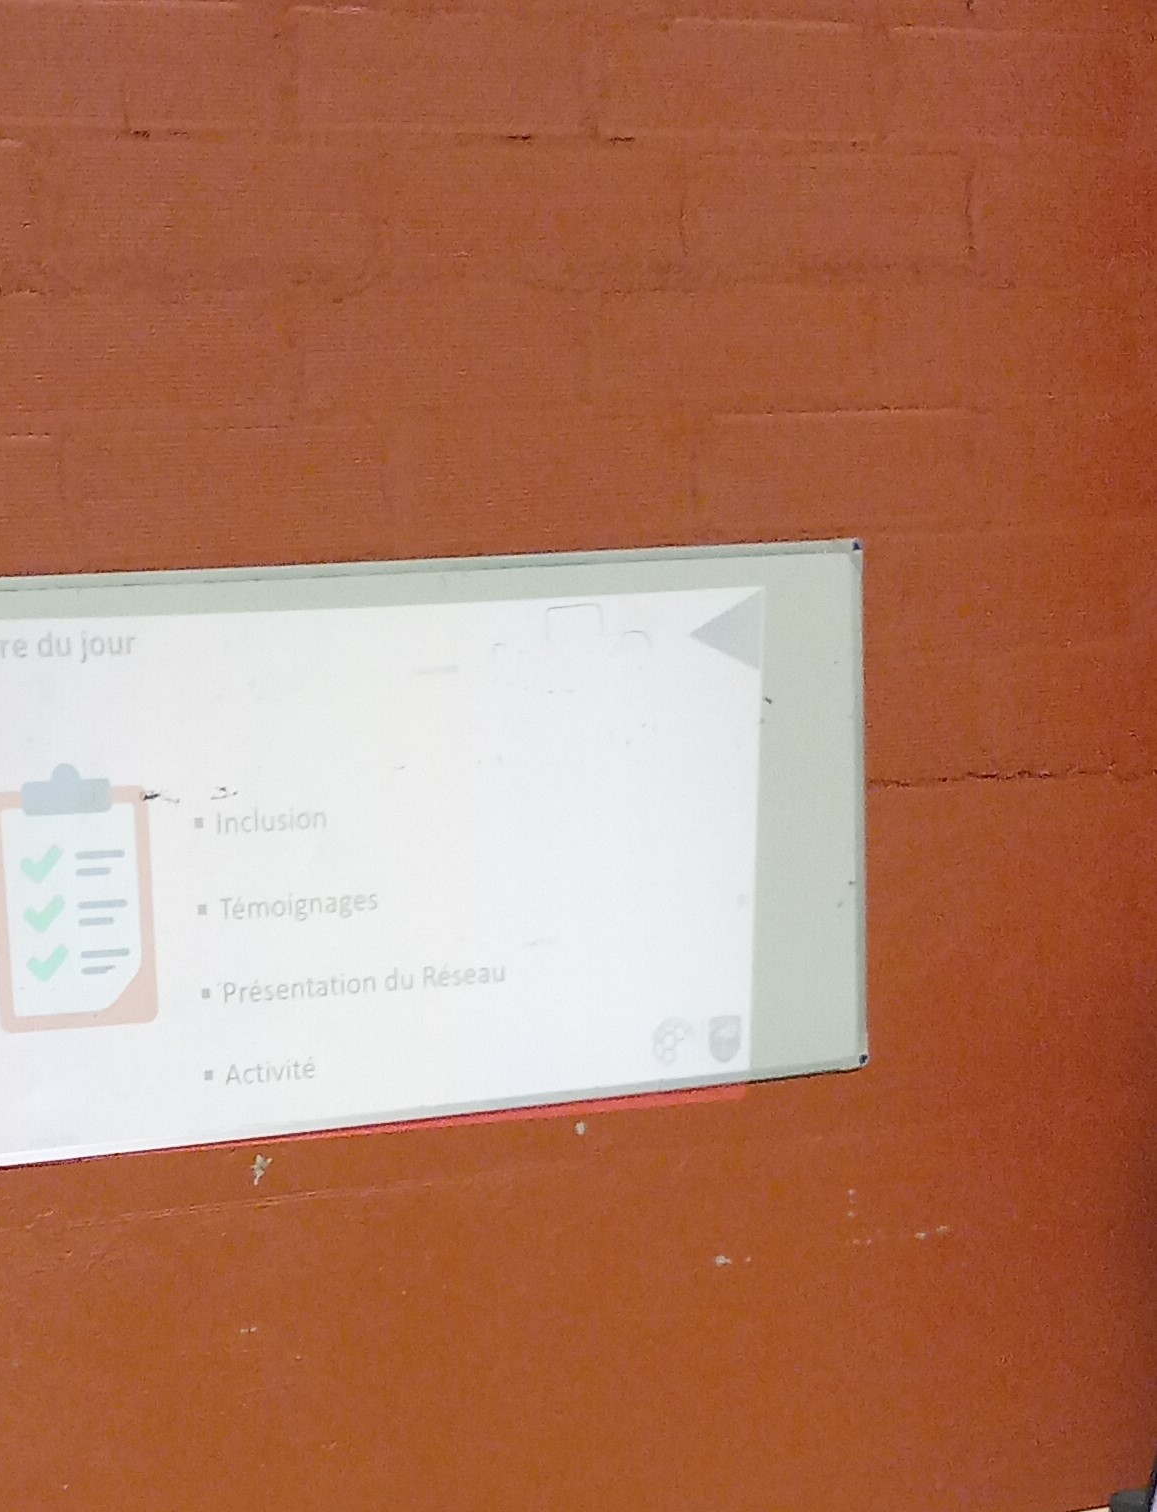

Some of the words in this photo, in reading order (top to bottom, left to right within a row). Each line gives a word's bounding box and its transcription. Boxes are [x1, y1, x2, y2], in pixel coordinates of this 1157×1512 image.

[37, 630, 71, 658] du
[80, 630, 136, 663] jour
[216, 806, 327, 835] Inclusion
[219, 893, 378, 922] Témoignages
[223, 974, 377, 1004] Présentation
[384, 966, 414, 991] du
[422, 963, 506, 988] Réseau
[225, 1056, 315, 1085] Activité
